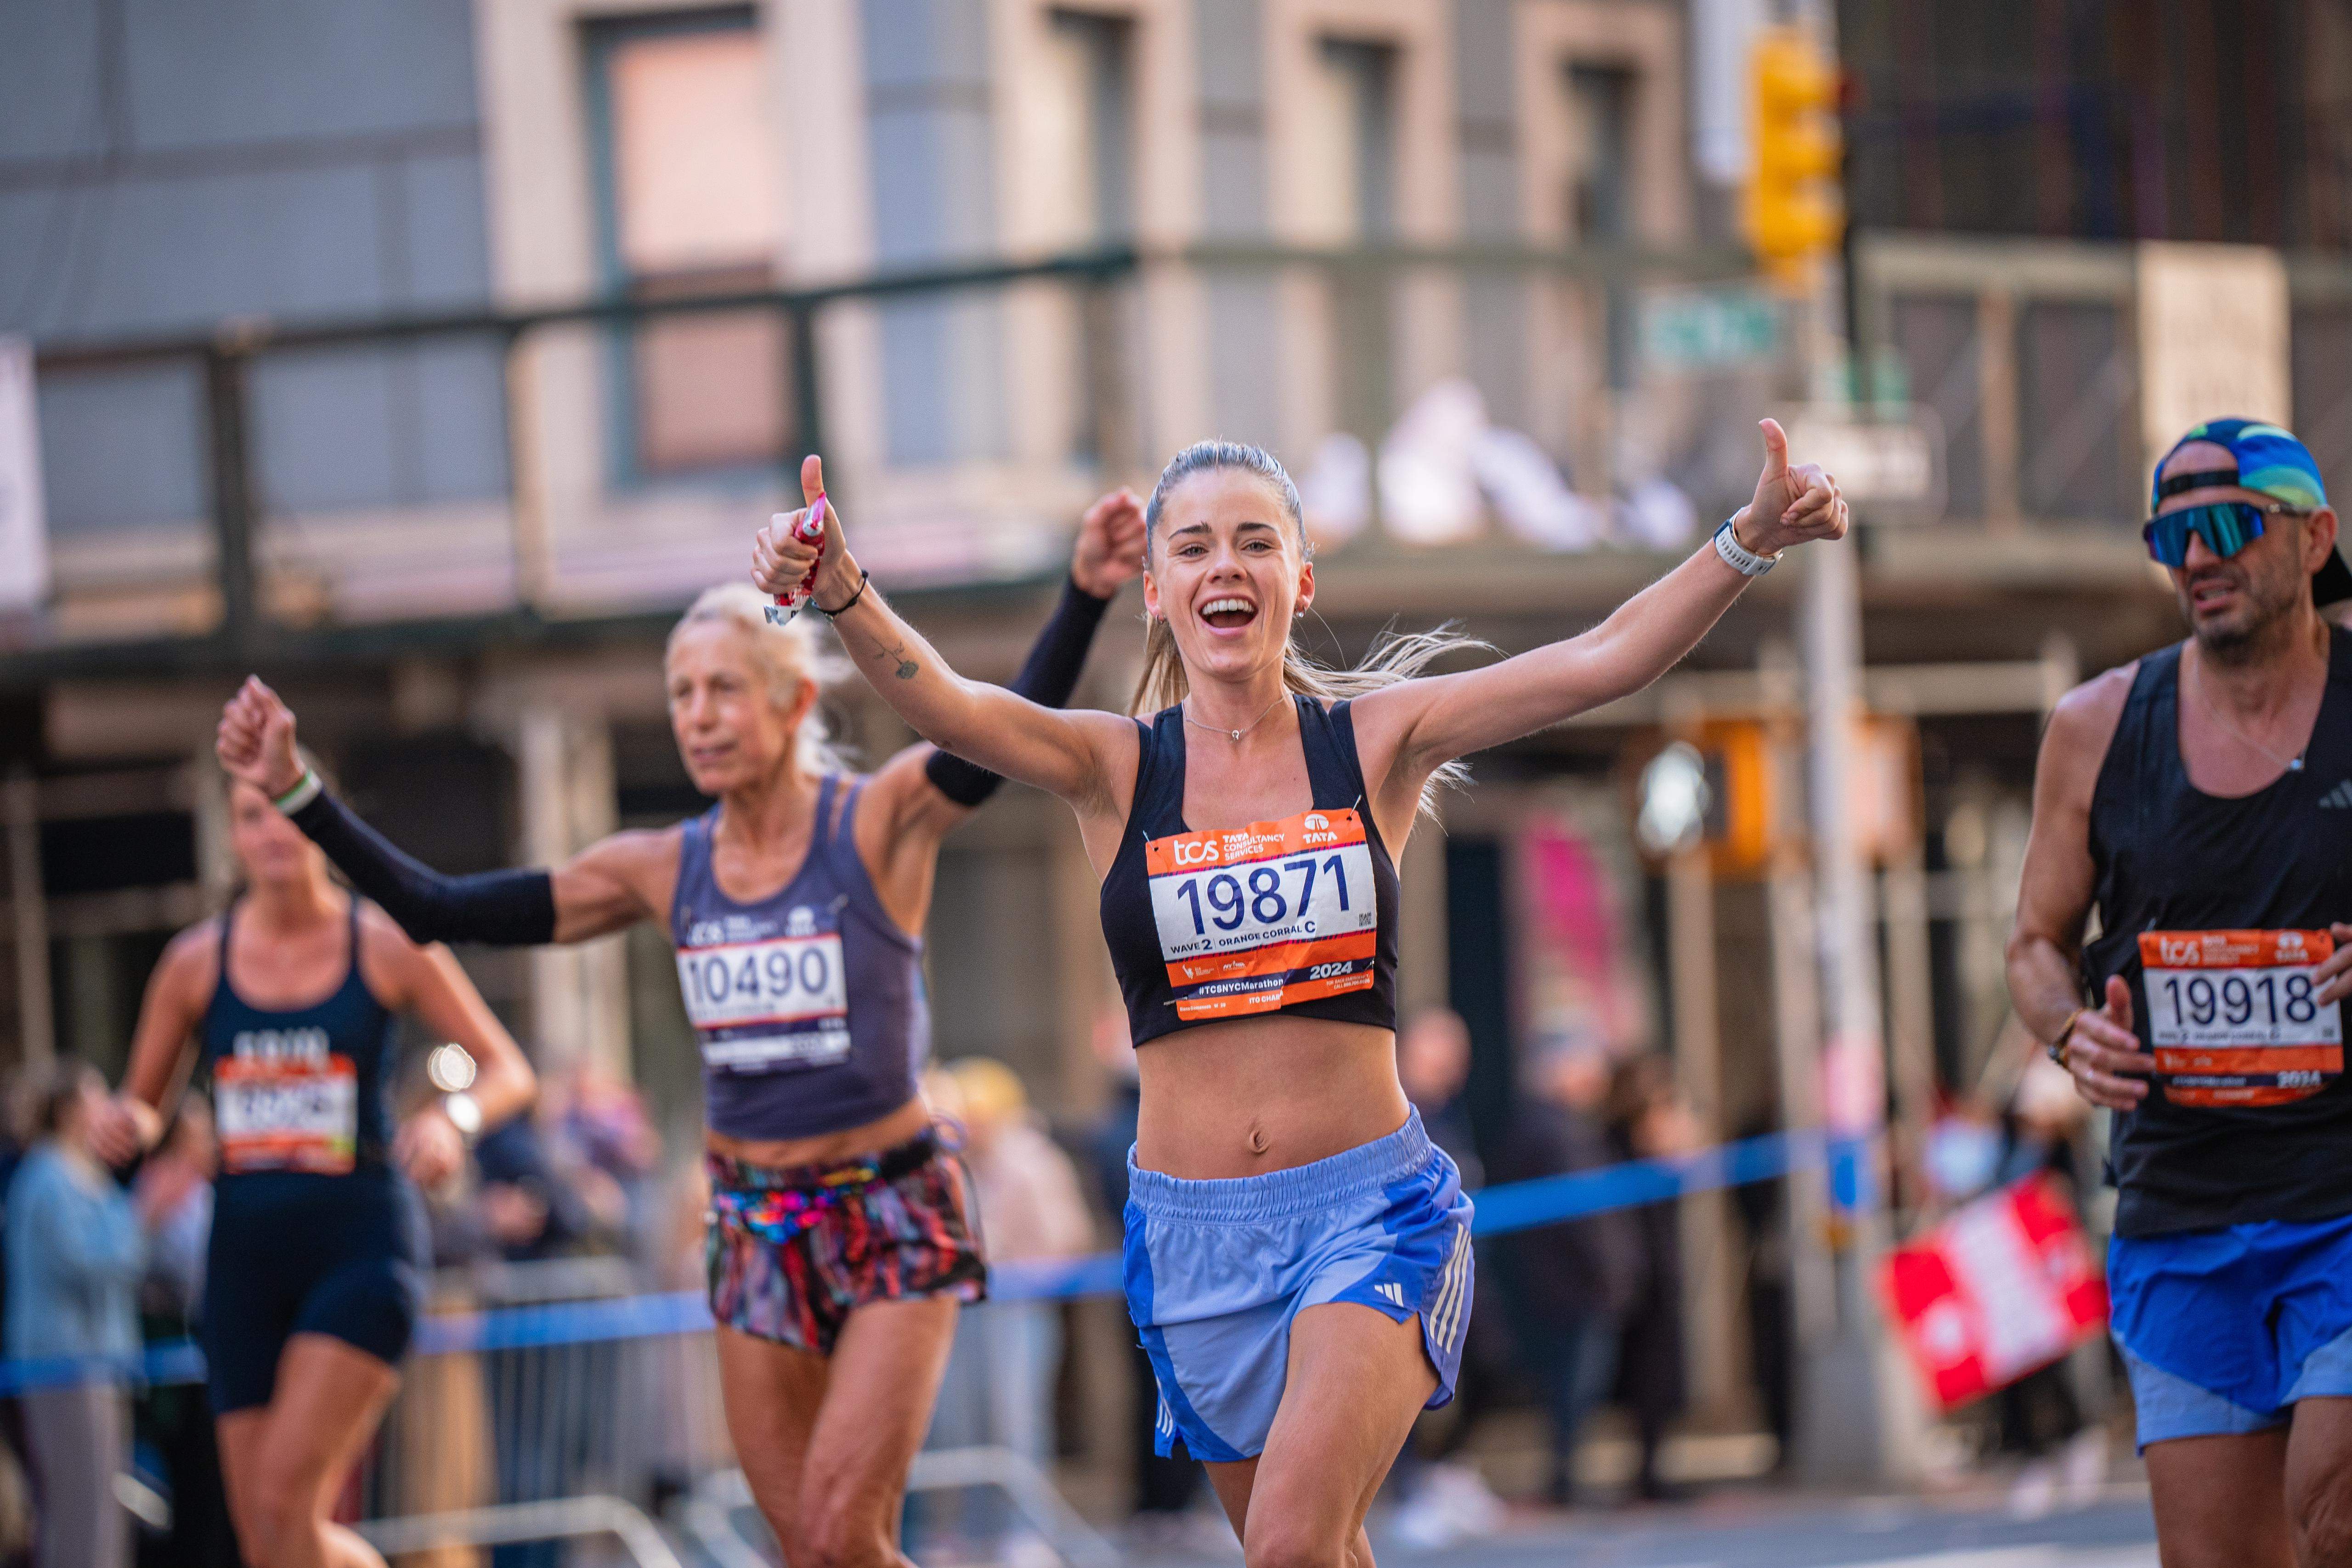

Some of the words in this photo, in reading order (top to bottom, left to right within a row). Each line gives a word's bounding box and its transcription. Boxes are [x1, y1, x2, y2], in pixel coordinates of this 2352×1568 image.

[1222, 832, 1249, 843] TATA
[1224, 833, 1285, 852] CONSULTANCY
[1303, 831, 1338, 844] TATA
[1174, 840, 1219, 865] tcs
[1225, 843, 1264, 861] SERVICES
[1177, 854, 1350, 936] 19871
[1219, 932, 1261, 947] ORANGE
[1262, 925, 1302, 939] CORRAL
[1304, 921, 1316, 933] C
[1170, 942, 1200, 954] WAVE
[1201, 939, 1213, 951] 2
[690, 947, 829, 1004] 10490
[1310, 960, 1352, 980] 2024
[1199, 978, 1283, 995] #TCSNYCMarathon
[2164, 974, 2316, 1026] 19918
